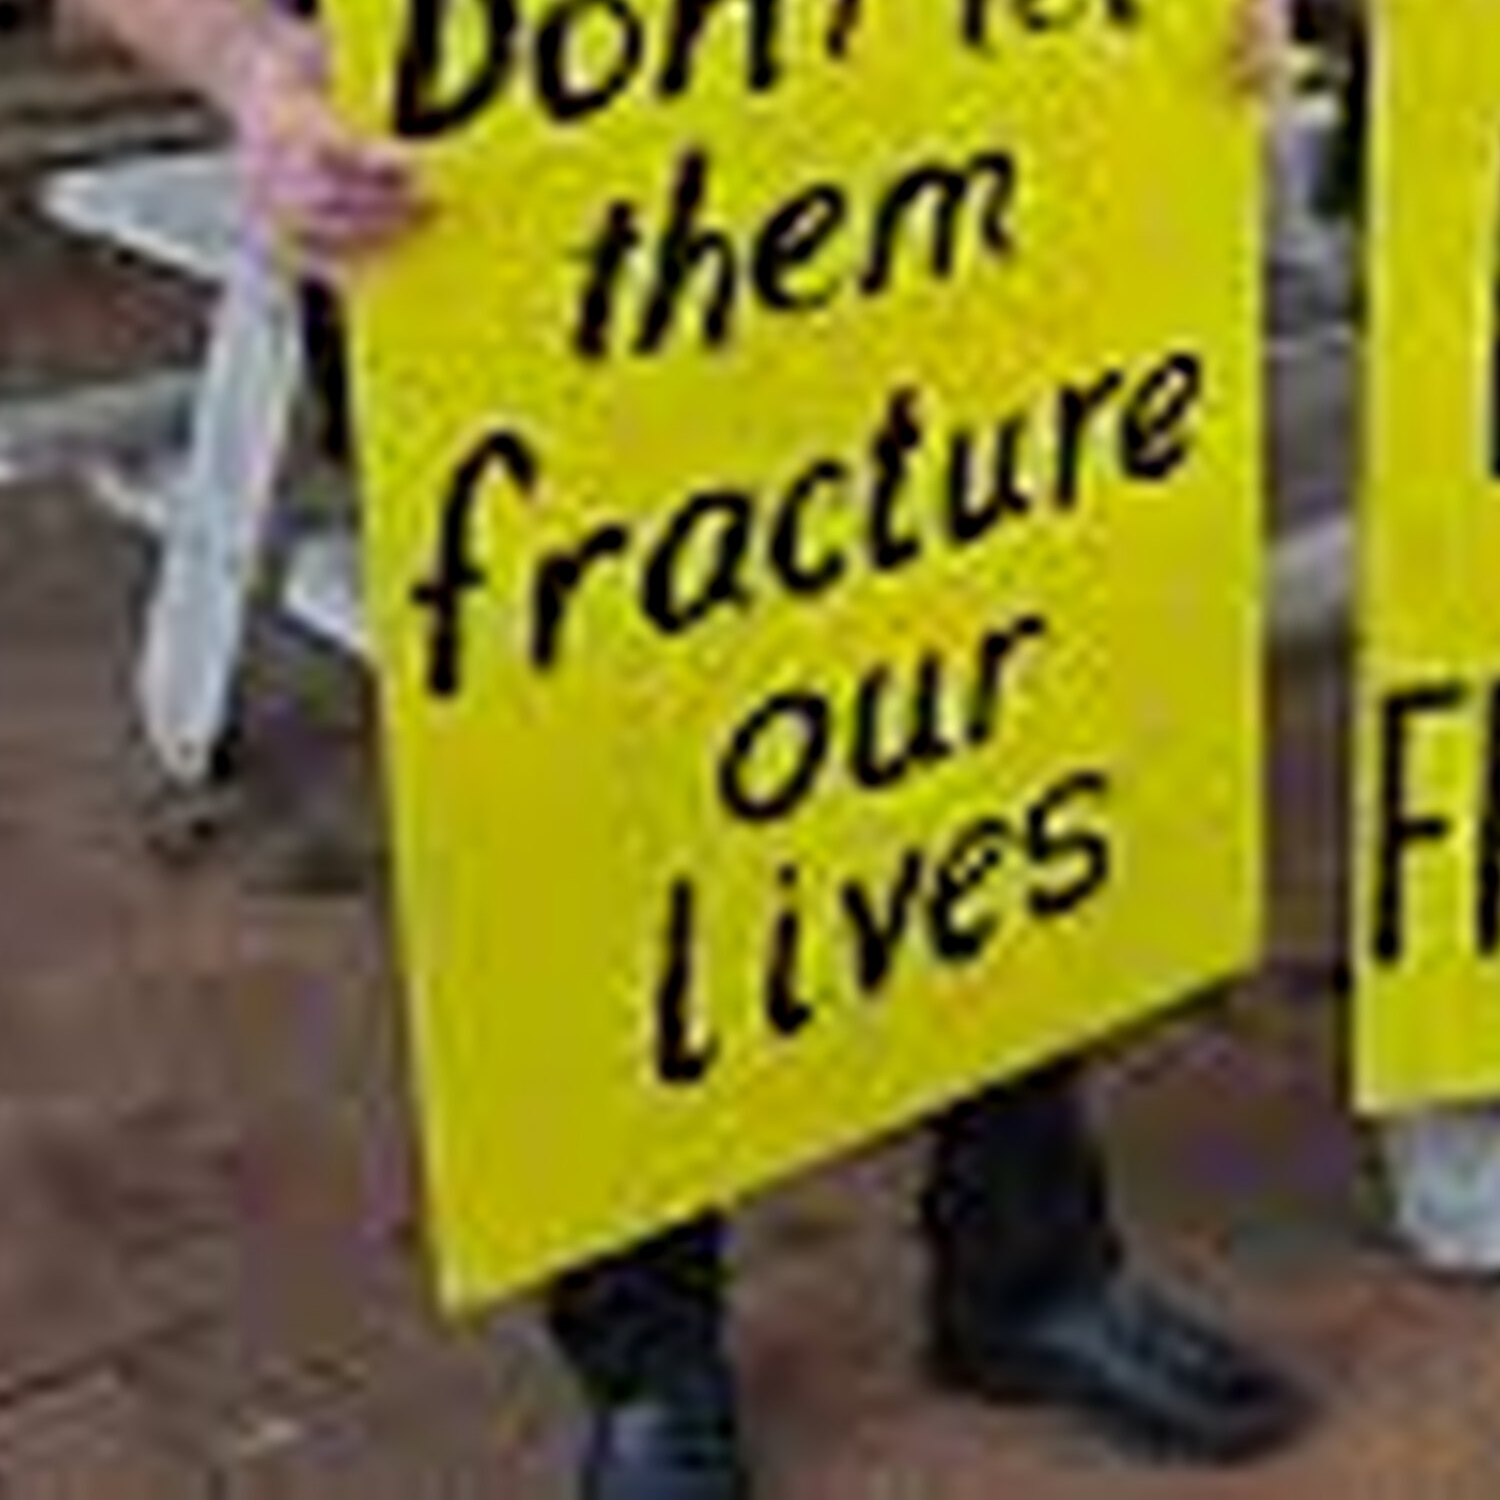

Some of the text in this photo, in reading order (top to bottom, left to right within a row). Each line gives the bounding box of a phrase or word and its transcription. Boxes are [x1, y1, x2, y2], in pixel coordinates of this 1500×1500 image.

[572, 149, 1014, 361] them
[410, 352, 1201, 697] fracture
[717, 613, 1046, 821] our
[654, 770, 1110, 1083] lives
